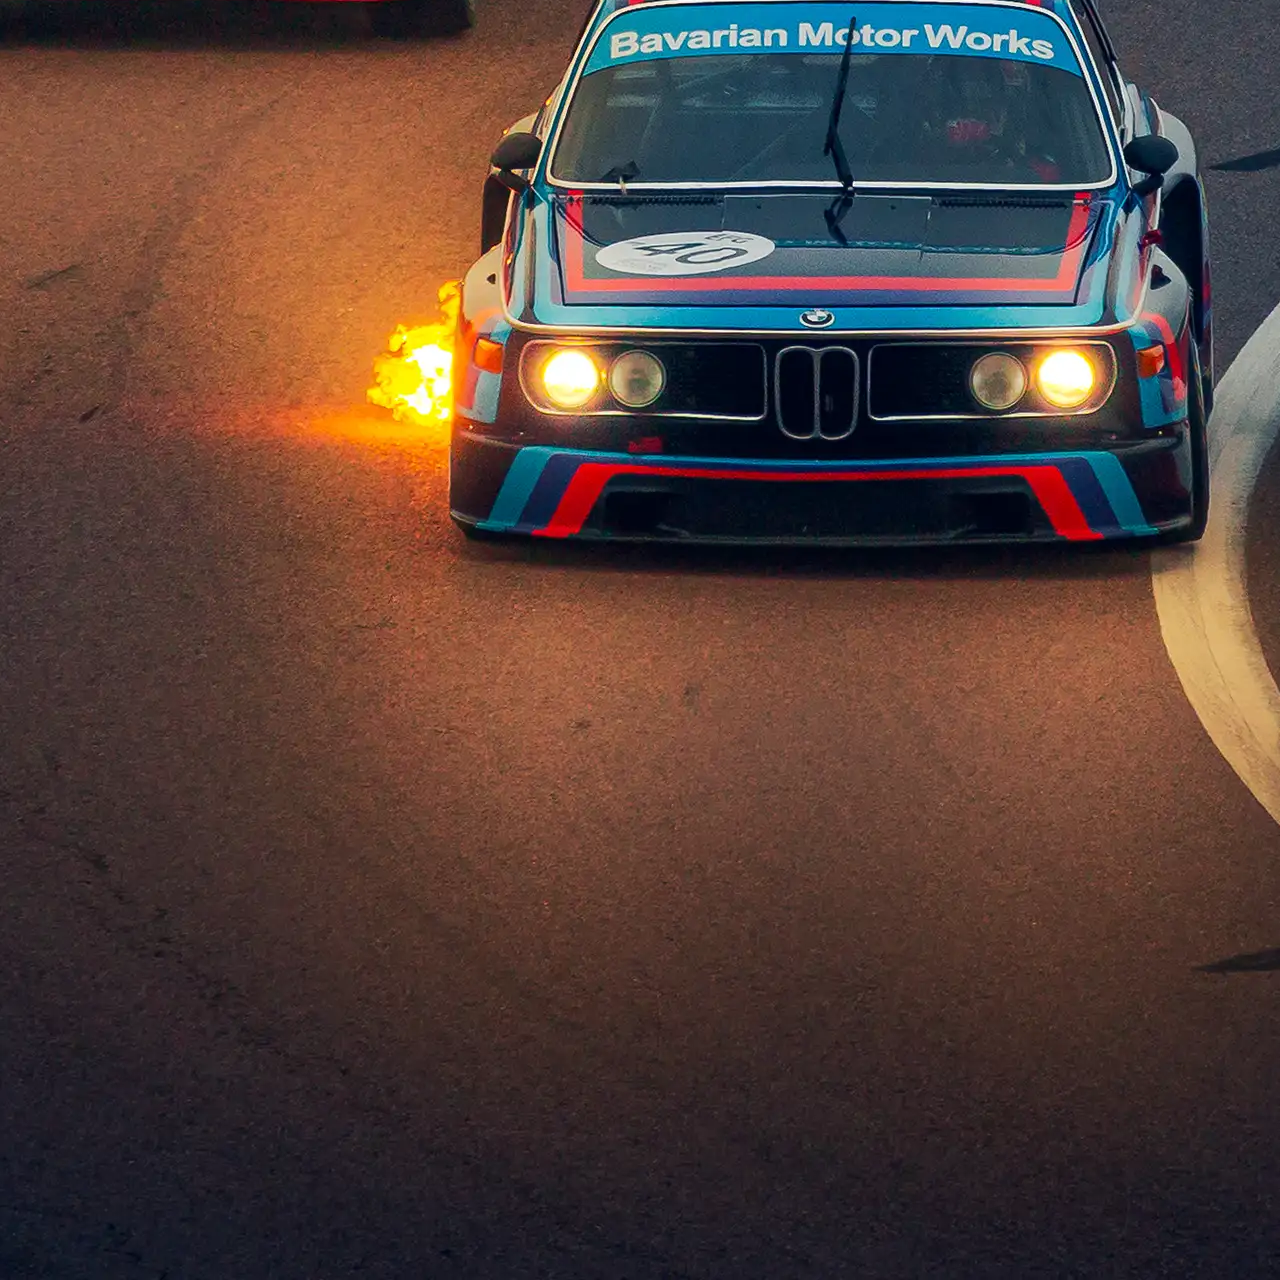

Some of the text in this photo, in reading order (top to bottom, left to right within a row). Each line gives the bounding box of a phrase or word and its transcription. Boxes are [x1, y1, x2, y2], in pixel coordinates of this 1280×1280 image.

[610, 21, 1055, 60] Bavarian Motor Works
[632, 241, 749, 265] 40
